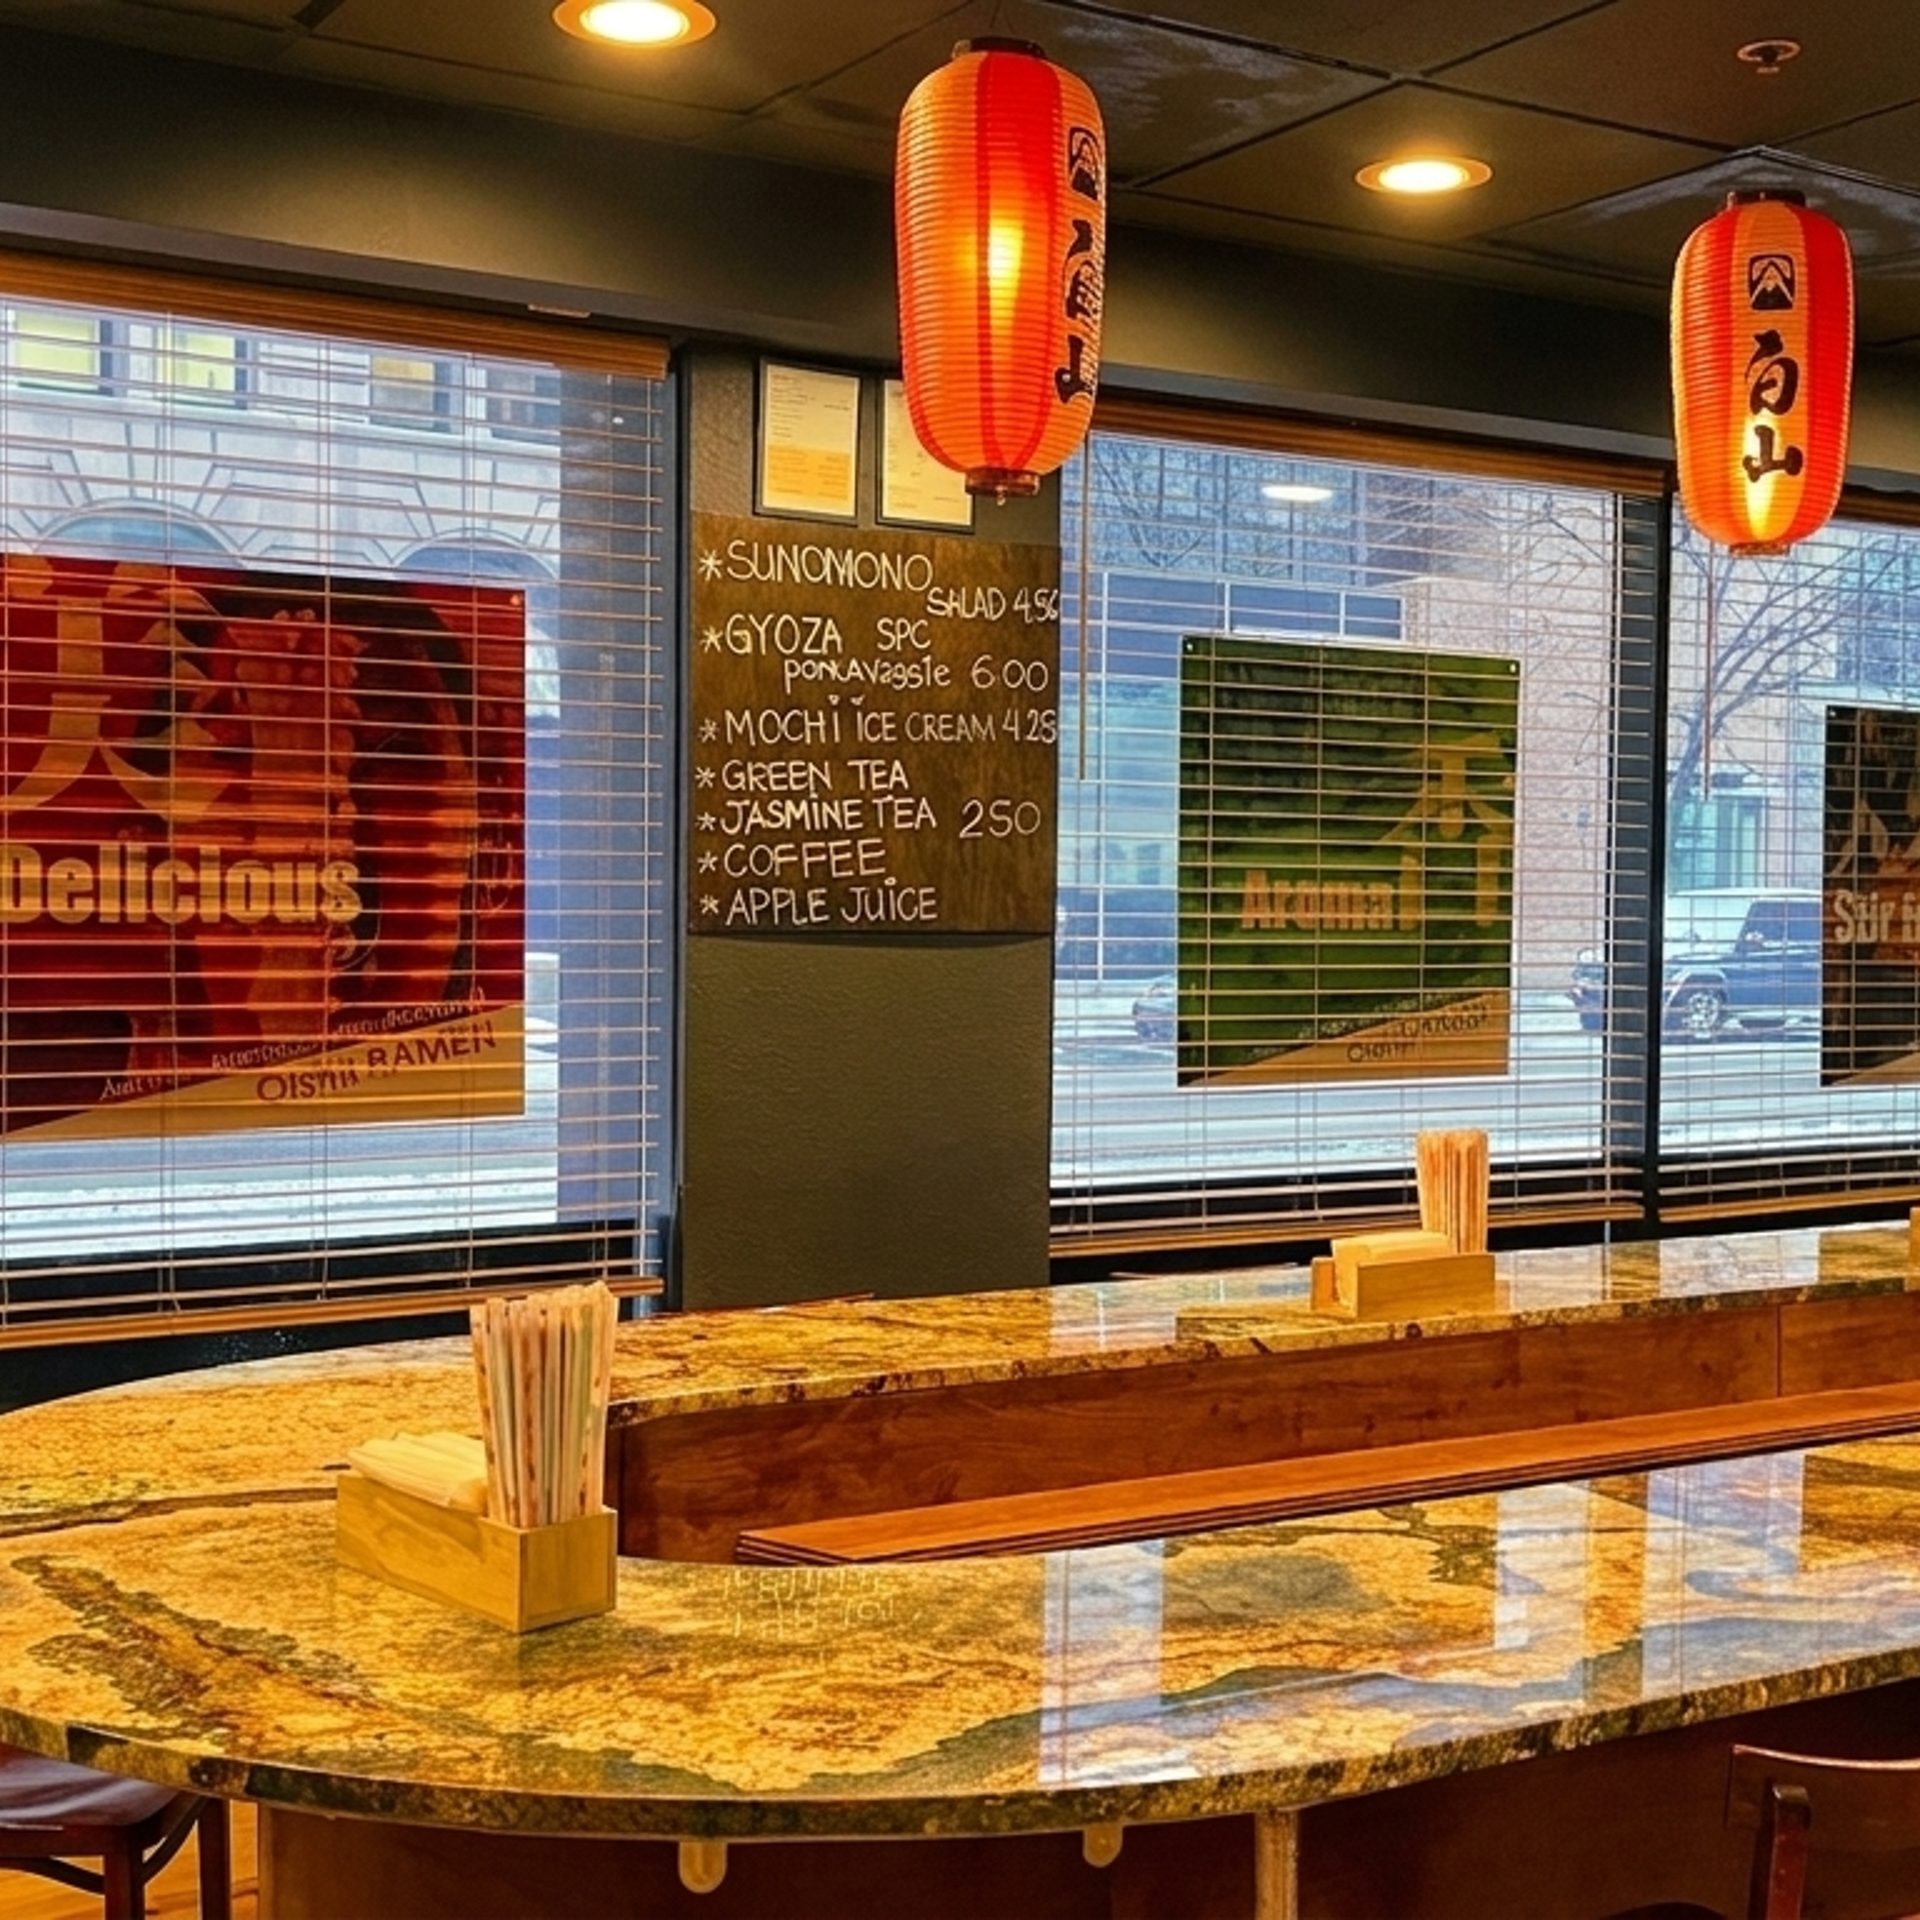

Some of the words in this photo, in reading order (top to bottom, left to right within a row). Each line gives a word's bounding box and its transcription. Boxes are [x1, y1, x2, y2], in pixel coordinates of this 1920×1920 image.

[726, 540, 934, 591] SUNOMONO
[726, 612, 843, 655] GYOZA
[850, 695, 898, 743] ICE
[904, 711, 997, 743] CREAM
[721, 759, 833, 792] GREEN
[847, 759, 910, 791] TEA
[719, 792, 864, 834] JASMINE
[871, 795, 938, 831] TEA
[723, 838, 887, 878] COFFEE
[0, 840, 363, 925] Delicious
[725, 886, 830, 927] APPLE
[840, 876, 939, 924] JUICE
[366, 1019, 497, 1078] RAMEN
